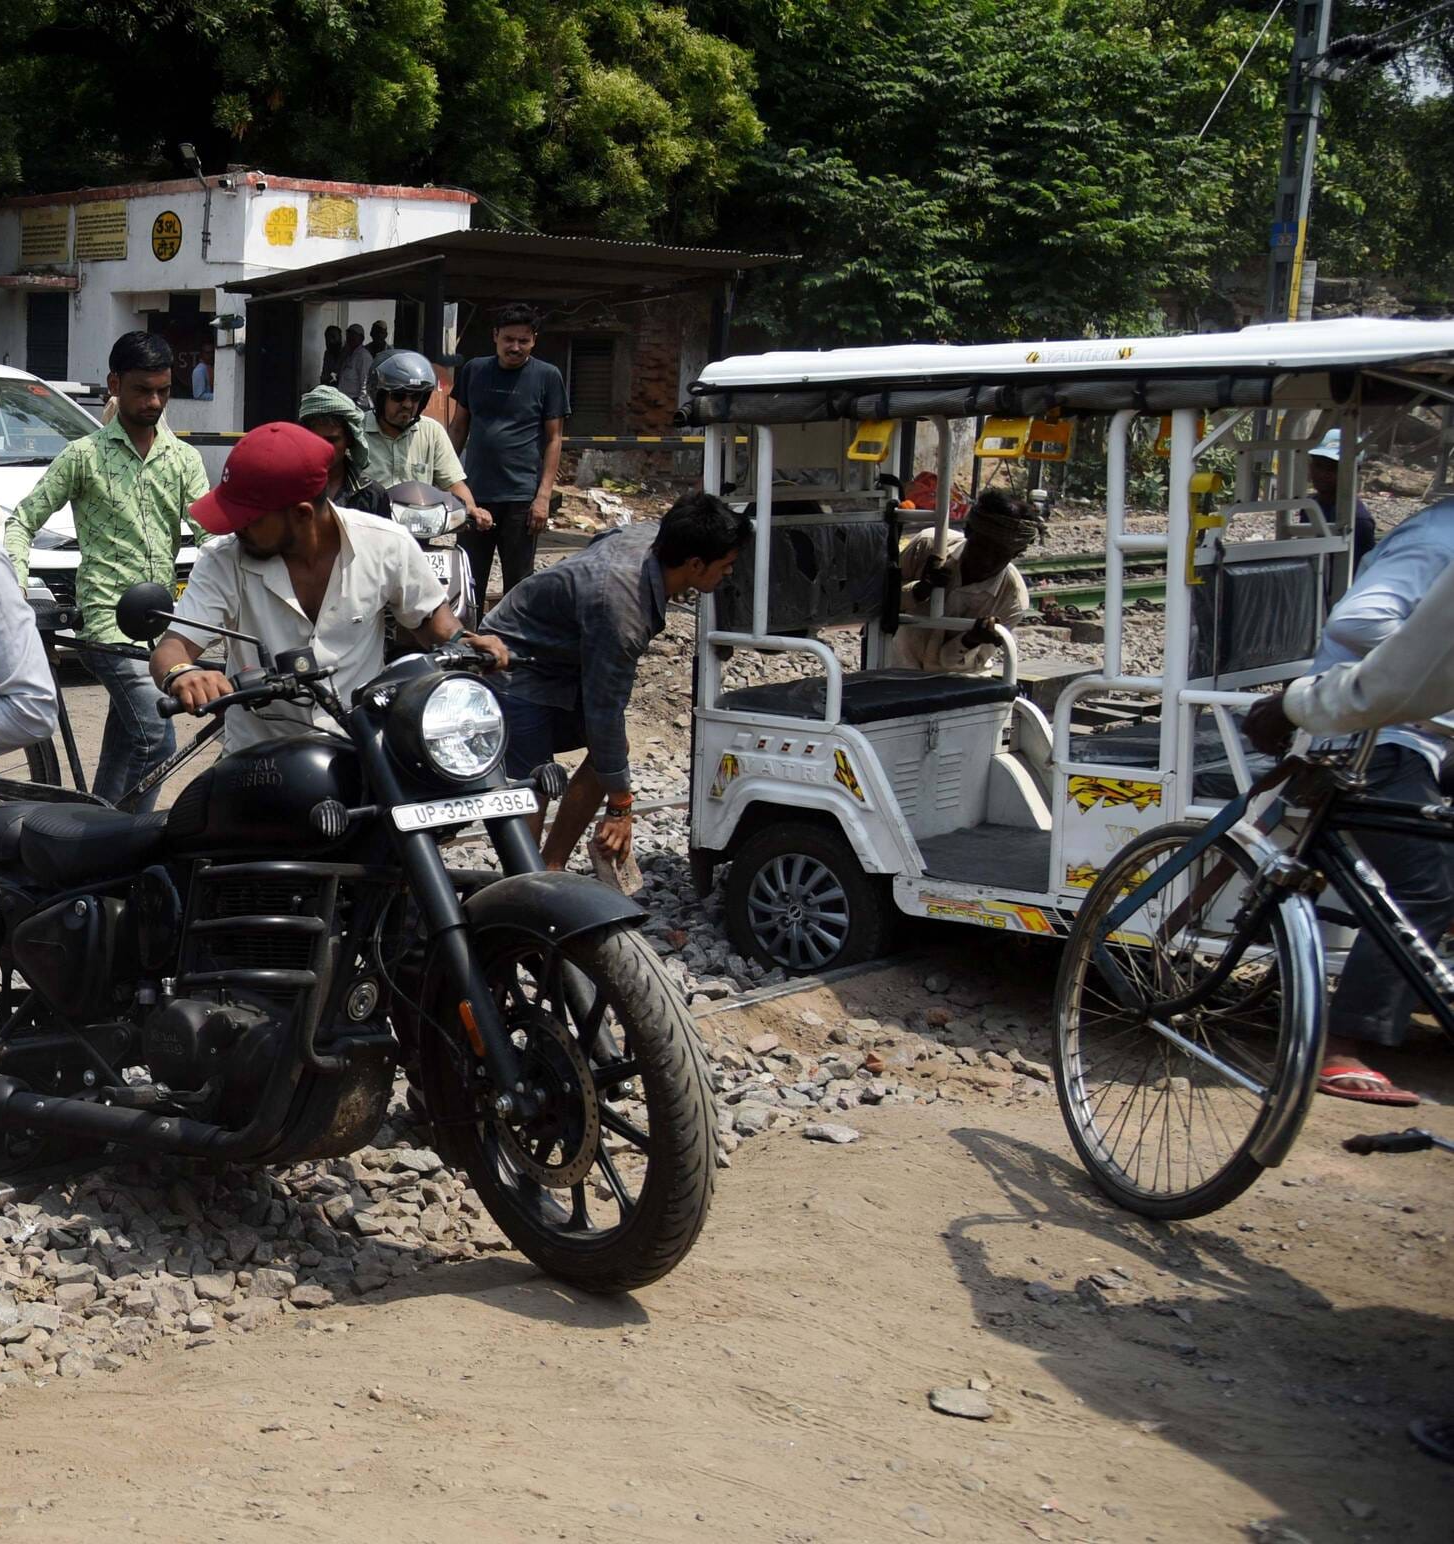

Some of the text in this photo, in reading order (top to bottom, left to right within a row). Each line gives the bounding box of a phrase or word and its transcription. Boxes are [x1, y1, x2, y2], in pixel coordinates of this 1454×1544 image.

[414, 790, 535, 823] UP 32RP 3964
